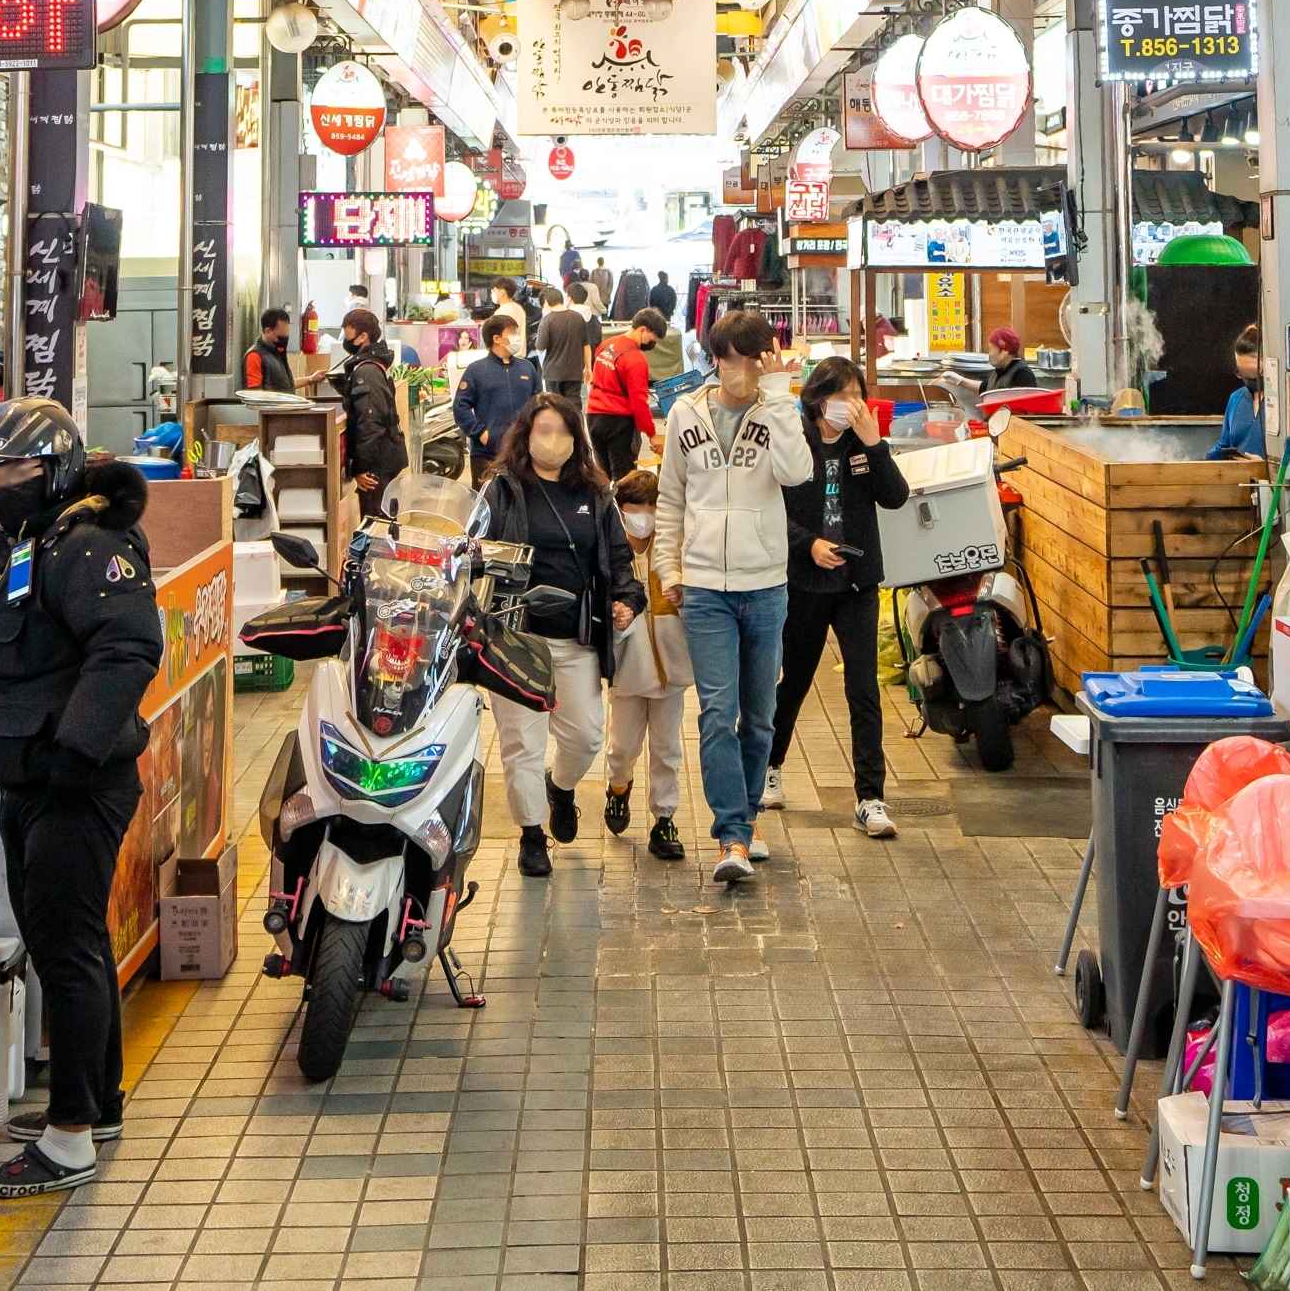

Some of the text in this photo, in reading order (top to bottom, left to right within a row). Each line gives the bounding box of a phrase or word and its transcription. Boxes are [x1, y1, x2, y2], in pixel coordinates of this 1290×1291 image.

[1112, 3, 1234, 37] 종가찜닭
[1120, 36, 1240, 57] T.856-1313
[582, 68, 674, 103] 안동찜닭
[0, 1184, 47, 1197] crocs
[1233, 1180, 1252, 1227] 청정
